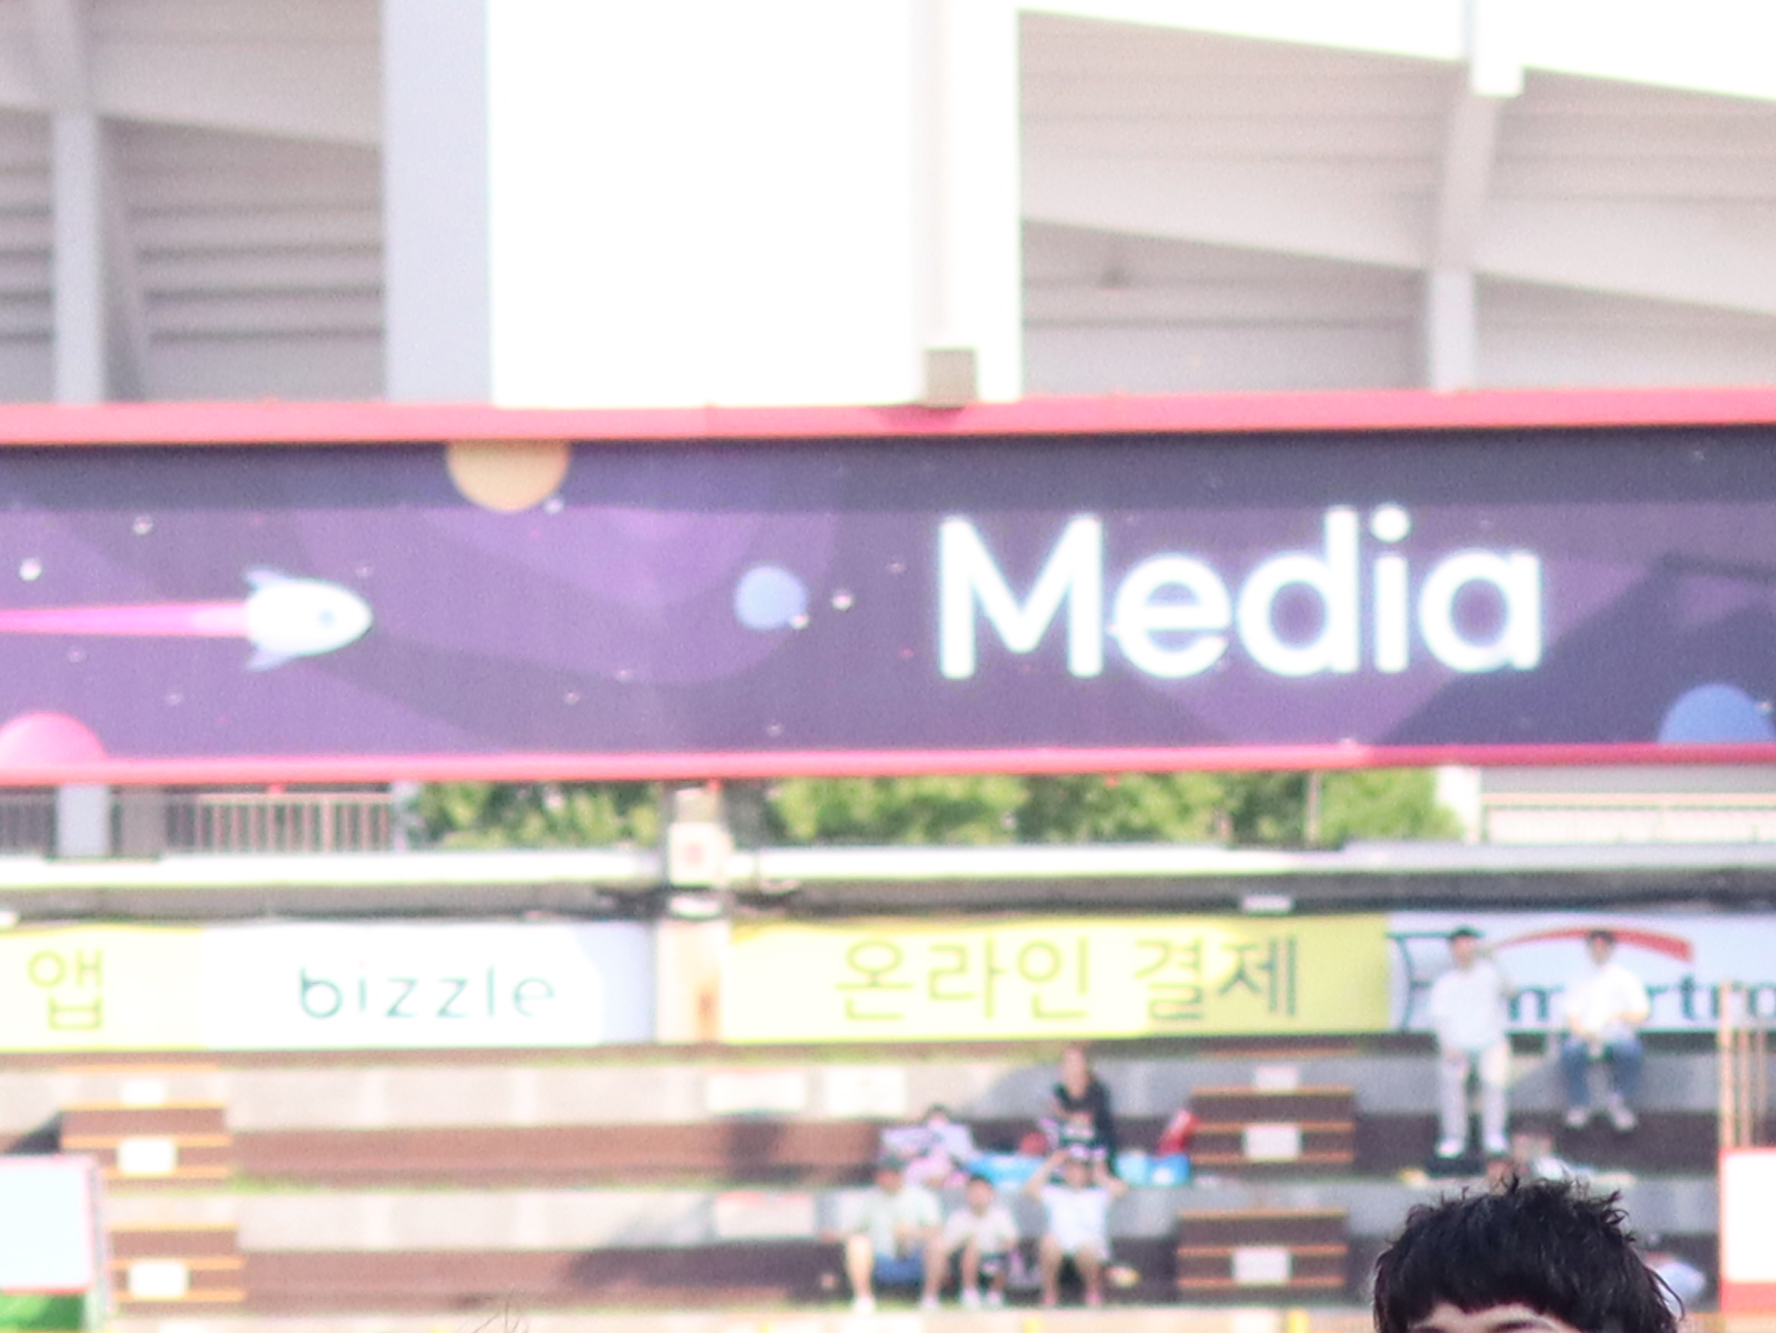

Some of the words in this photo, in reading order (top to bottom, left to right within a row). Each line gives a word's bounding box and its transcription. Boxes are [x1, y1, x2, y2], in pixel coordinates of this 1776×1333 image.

[937, 503, 1543, 680] Media
[26, 948, 107, 1031] 앱
[299, 963, 557, 1019] bizzle
[835, 937, 1091, 1022] 온라인
[1134, 935, 1299, 1022] 결제
